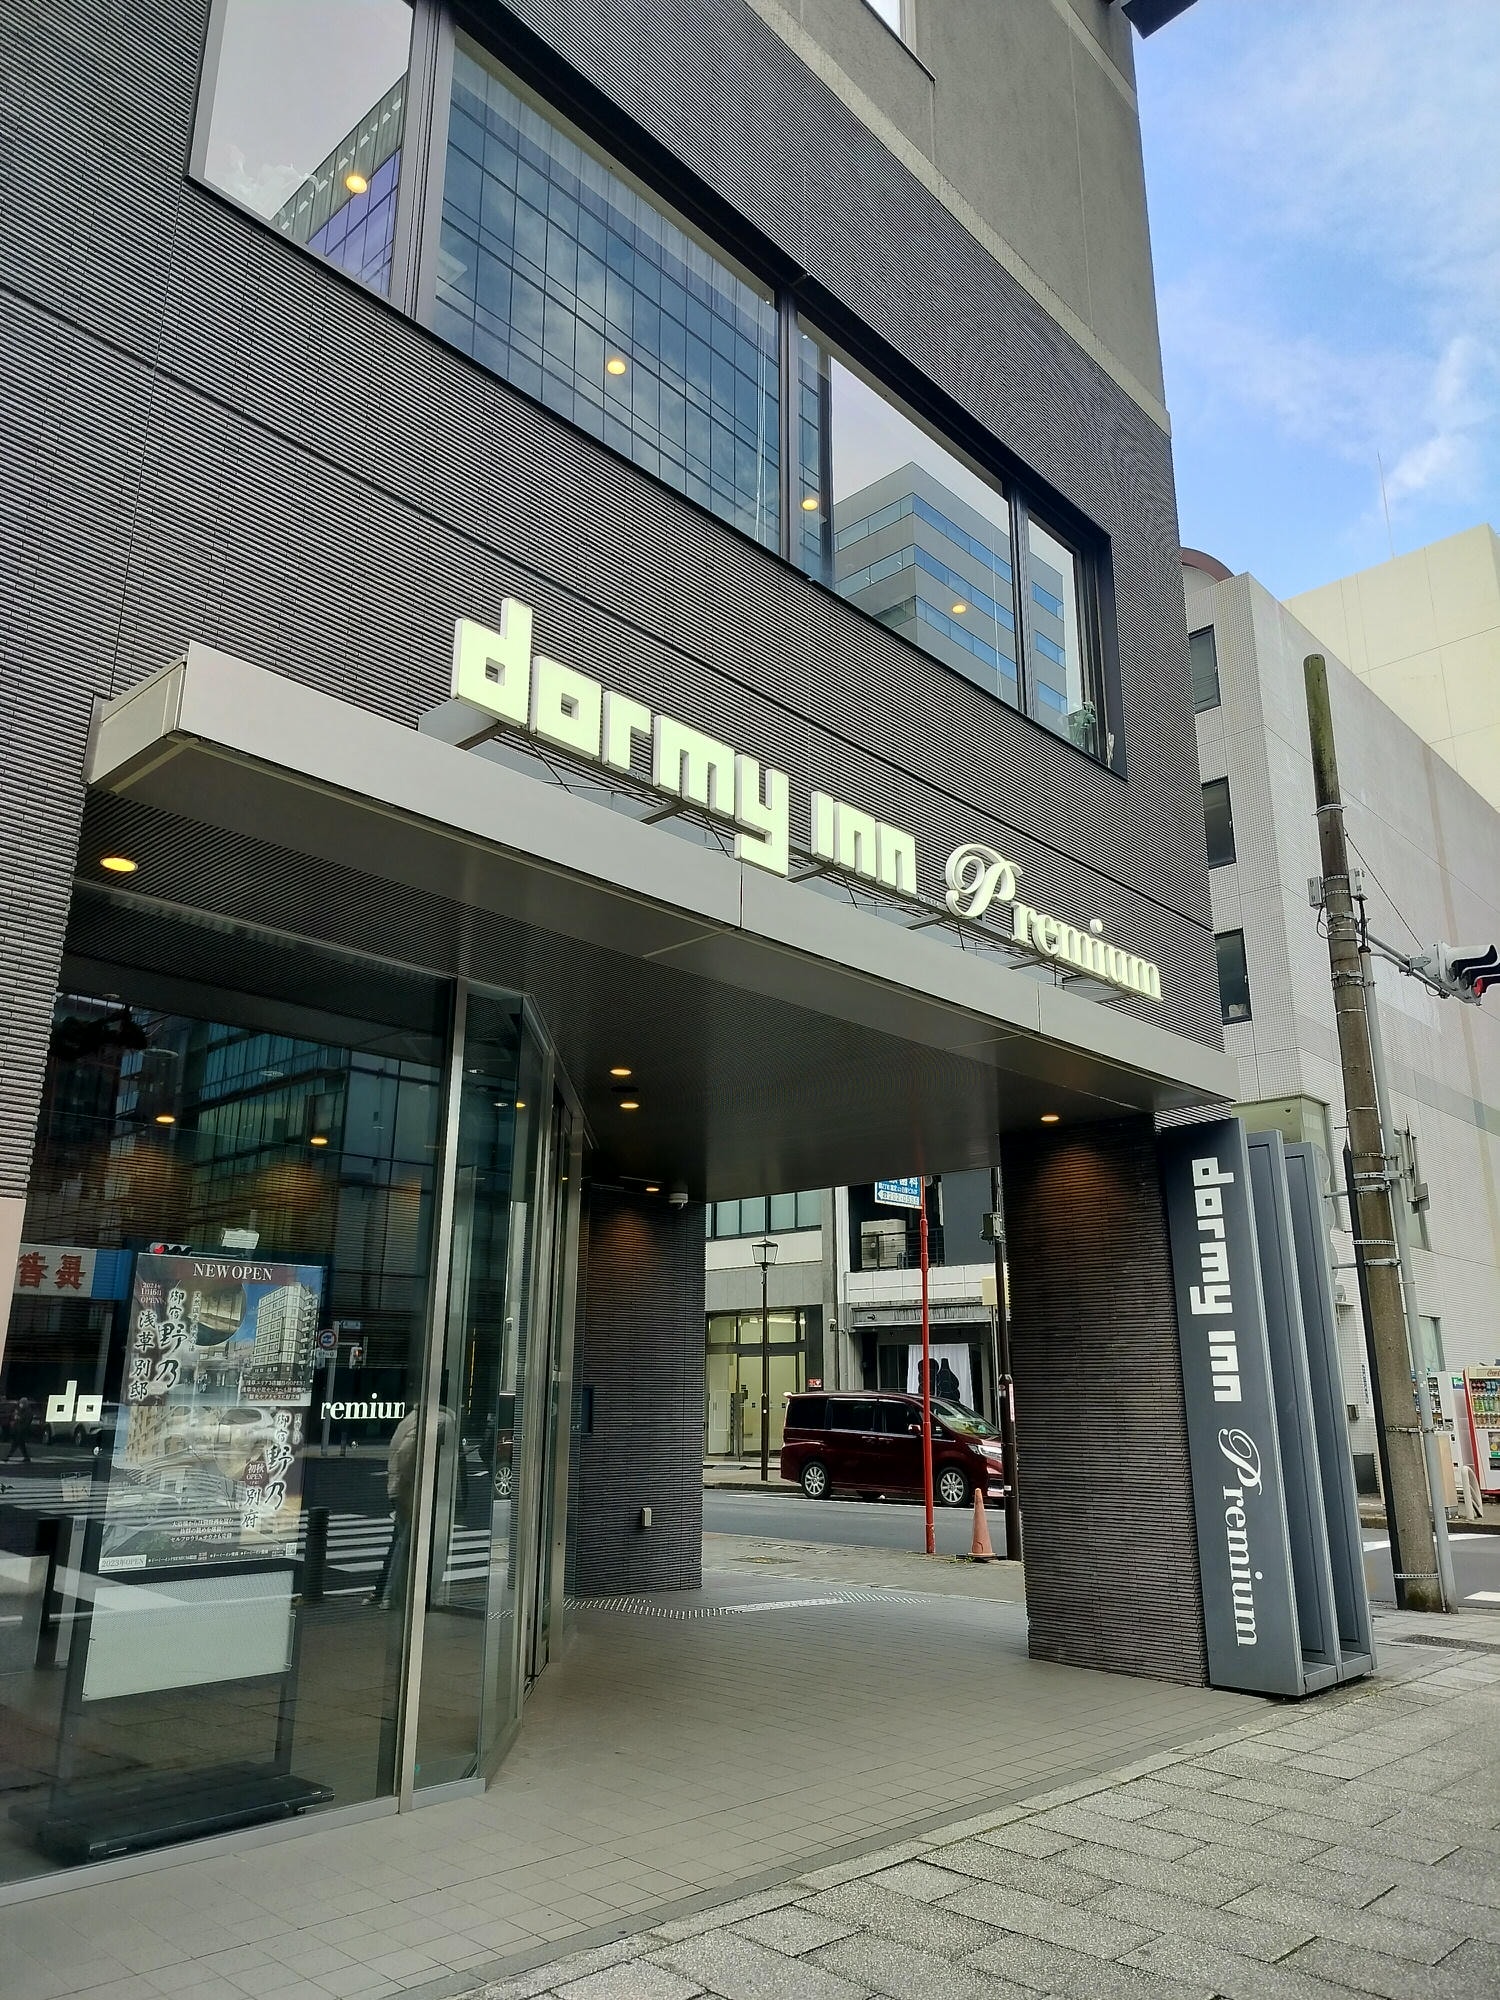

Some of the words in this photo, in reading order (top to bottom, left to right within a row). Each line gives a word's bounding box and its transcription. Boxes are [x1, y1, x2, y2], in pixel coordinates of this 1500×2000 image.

[451, 597, 790, 877] dormy
[811, 790, 917, 895] inn
[945, 843, 1163, 1003] Premium
[193, 1262, 230, 1278] NEW
[231, 1265, 273, 1281] OPEN
[1189, 1157, 1234, 1315] dormy
[1208, 1330, 1242, 1402] inn
[242, 1488, 262, 1528] 別府
[1218, 1428, 1263, 1647] Premium
